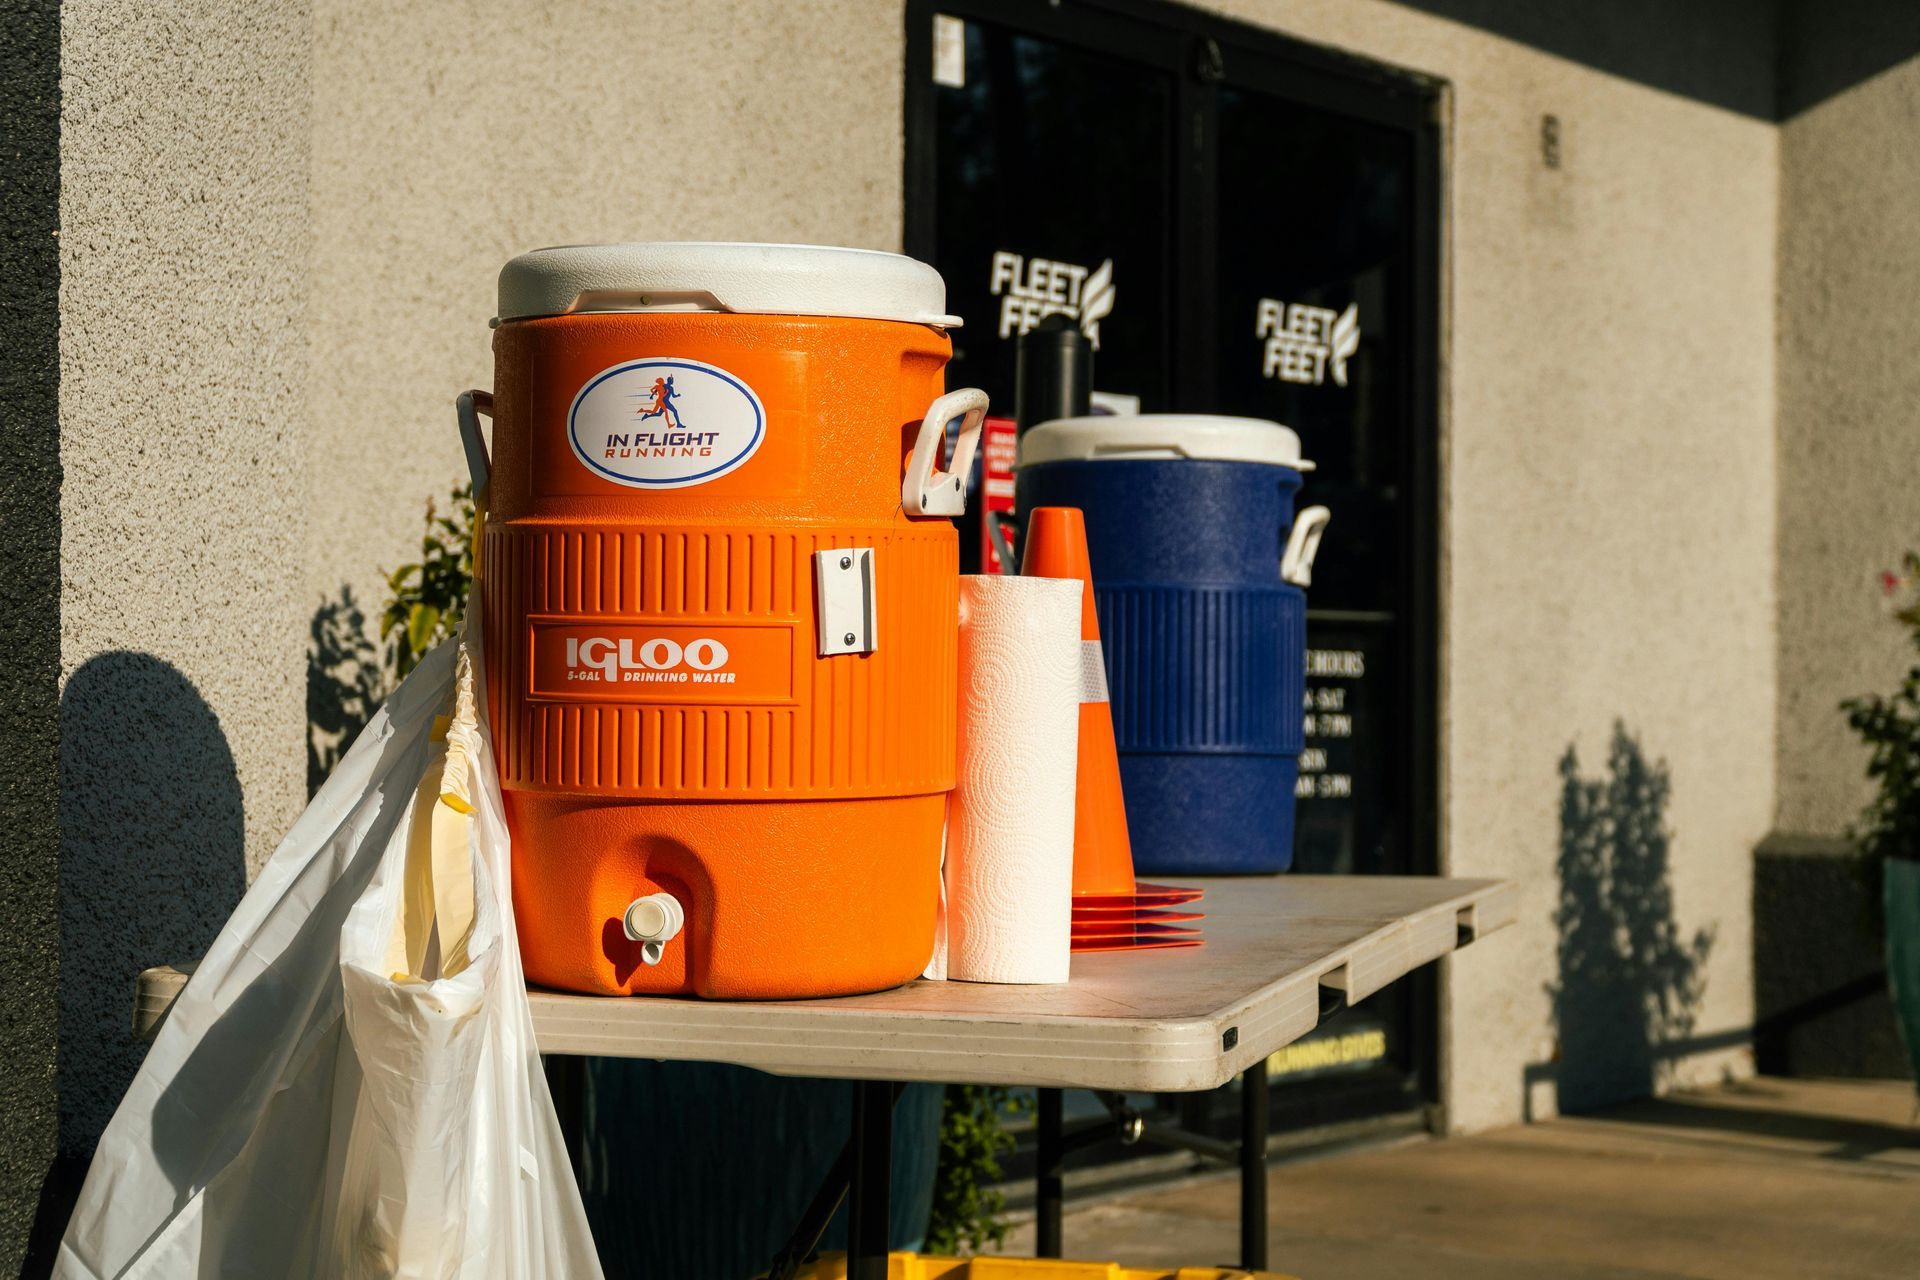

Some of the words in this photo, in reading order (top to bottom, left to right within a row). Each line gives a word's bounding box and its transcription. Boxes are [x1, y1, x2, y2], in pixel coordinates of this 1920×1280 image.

[990, 250, 1088, 306] FLEET
[1256, 298, 1338, 345] FLEET
[1262, 338, 1330, 386] FEET
[604, 447, 713, 459] RUNNING
[606, 433, 630, 447] IN
[634, 432, 719, 447] FLIGHT
[566, 637, 729, 683] IGLOO
[567, 670, 601, 682] 5-GAL
[623, 671, 688, 683] DRINKING
[692, 673, 736, 684] WATER
[1314, 649, 1365, 679] HOURS
